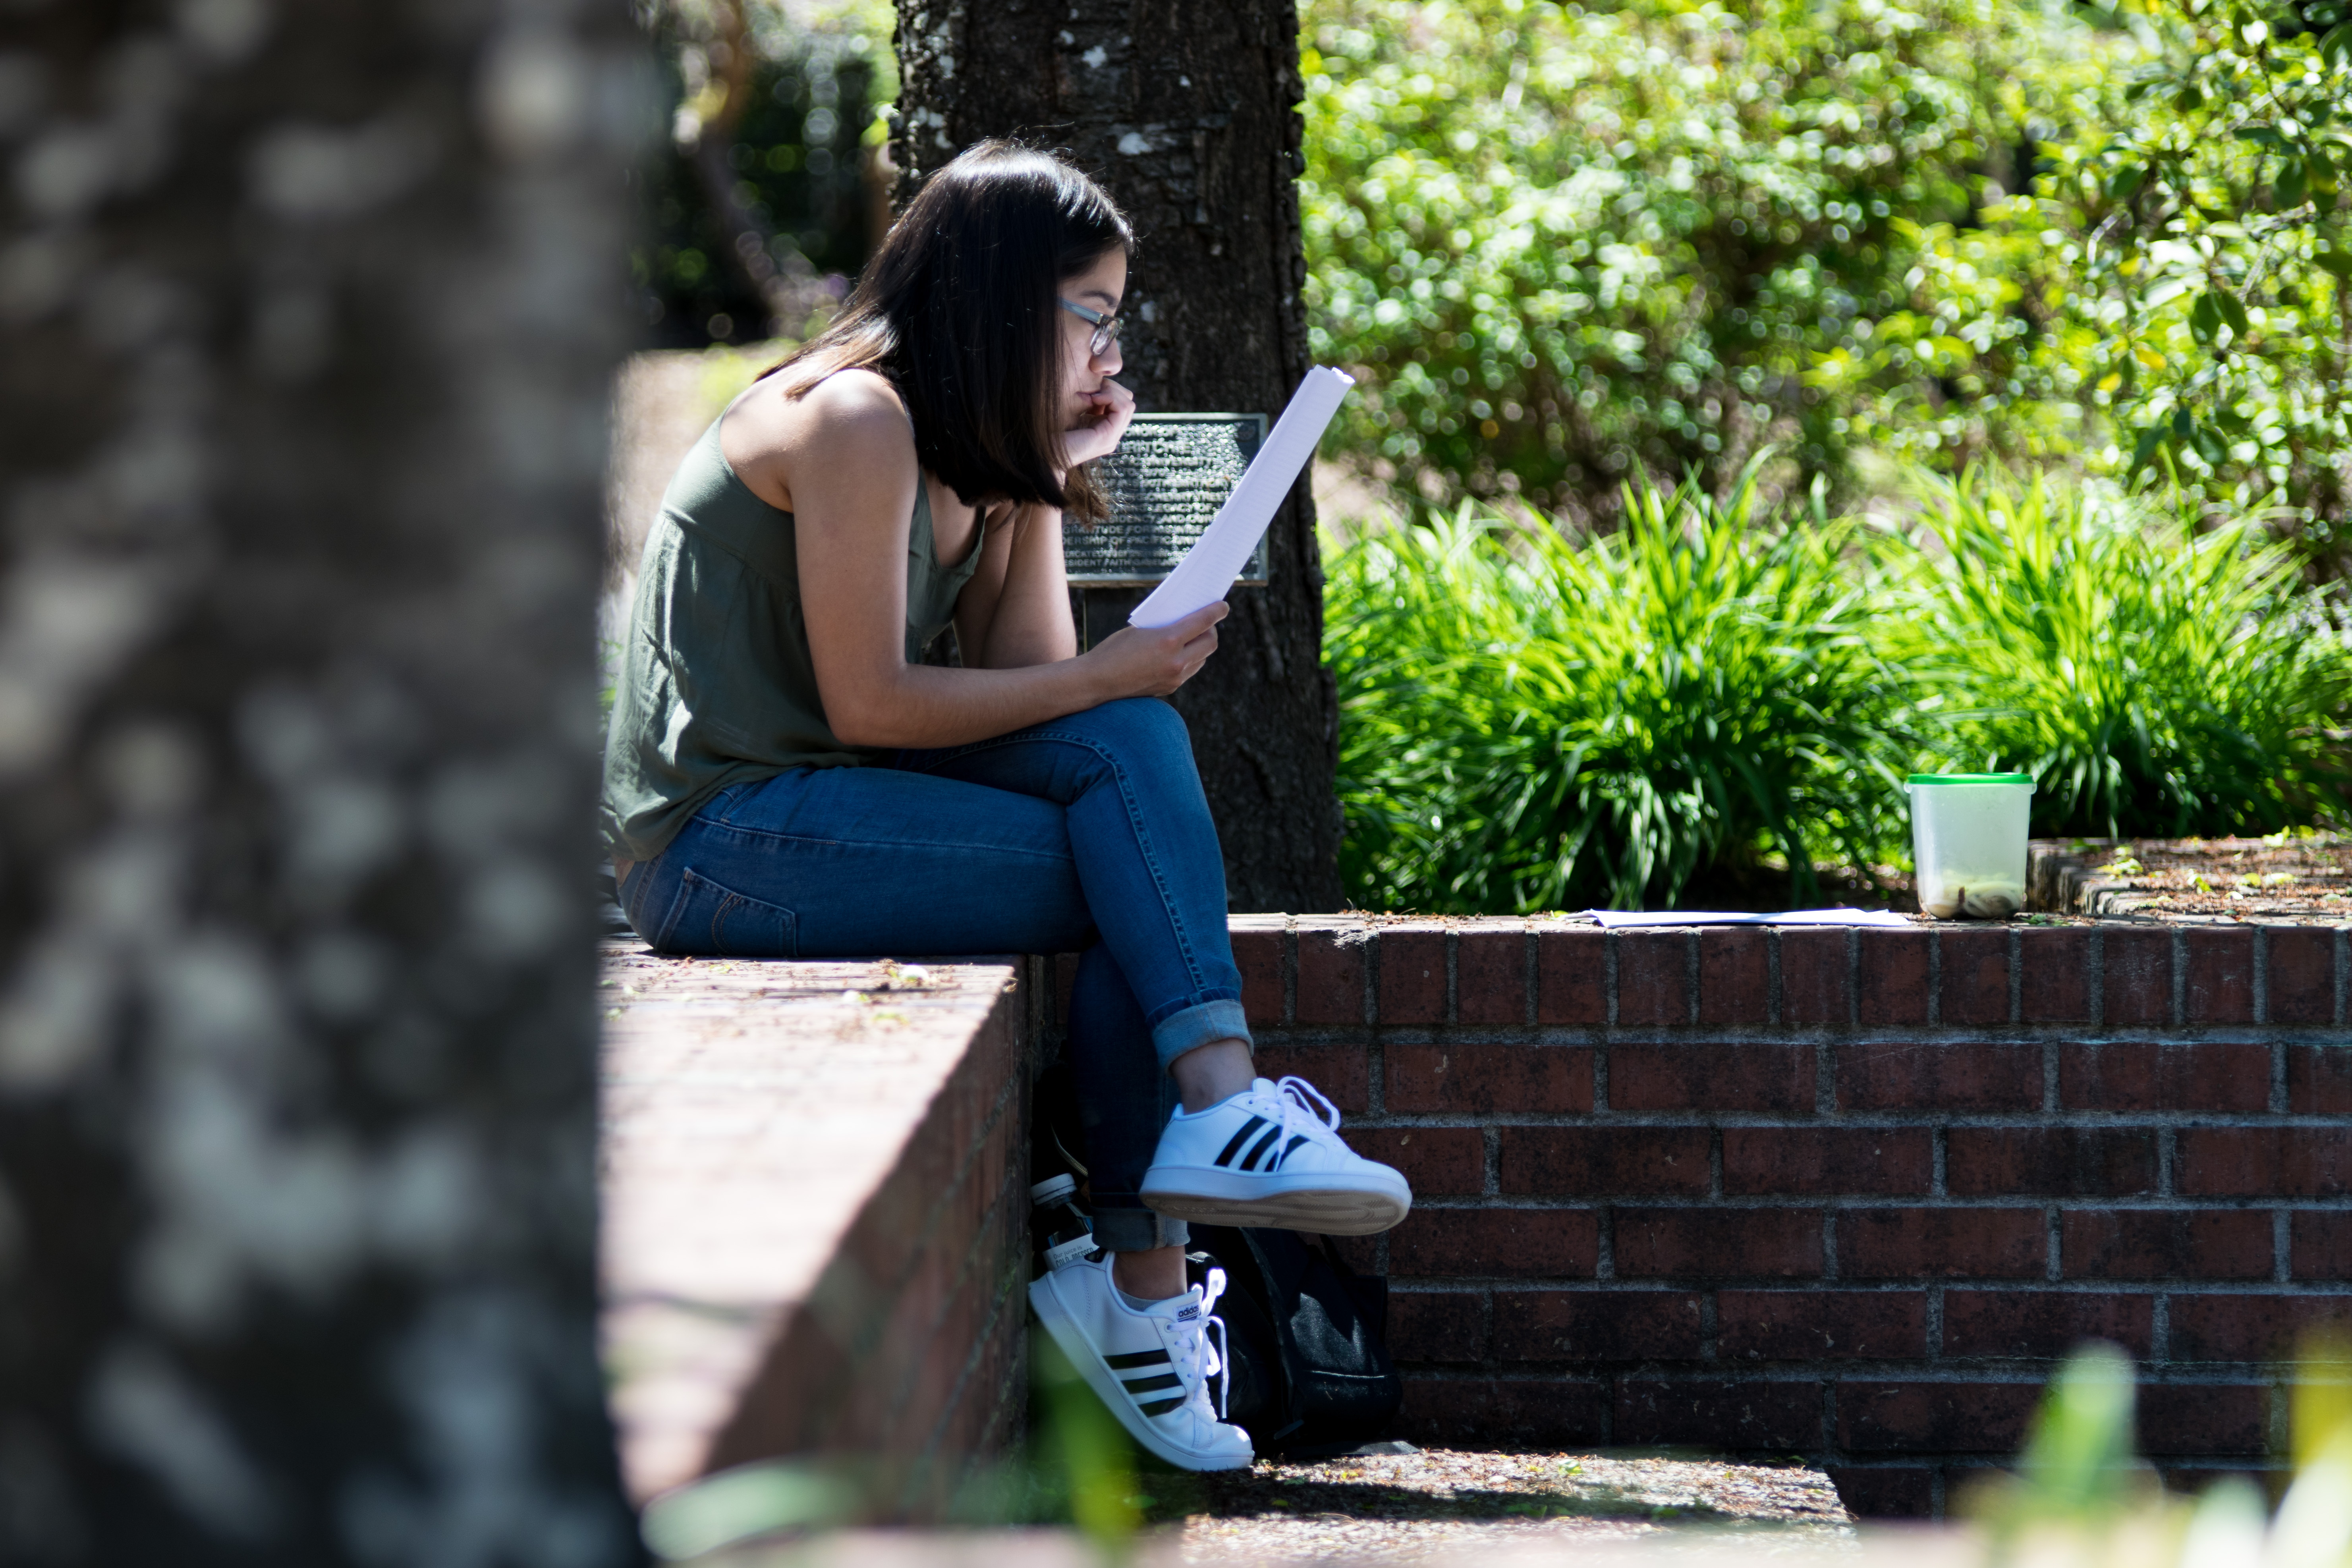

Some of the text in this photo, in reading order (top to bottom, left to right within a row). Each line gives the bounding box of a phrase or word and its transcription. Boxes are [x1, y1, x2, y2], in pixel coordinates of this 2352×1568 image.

[1124, 426, 1157, 436] ONOR
[1195, 492, 1224, 502] TREE
[1064, 1248, 1077, 1257] juice
[1178, 1305, 1199, 1317] adidas
